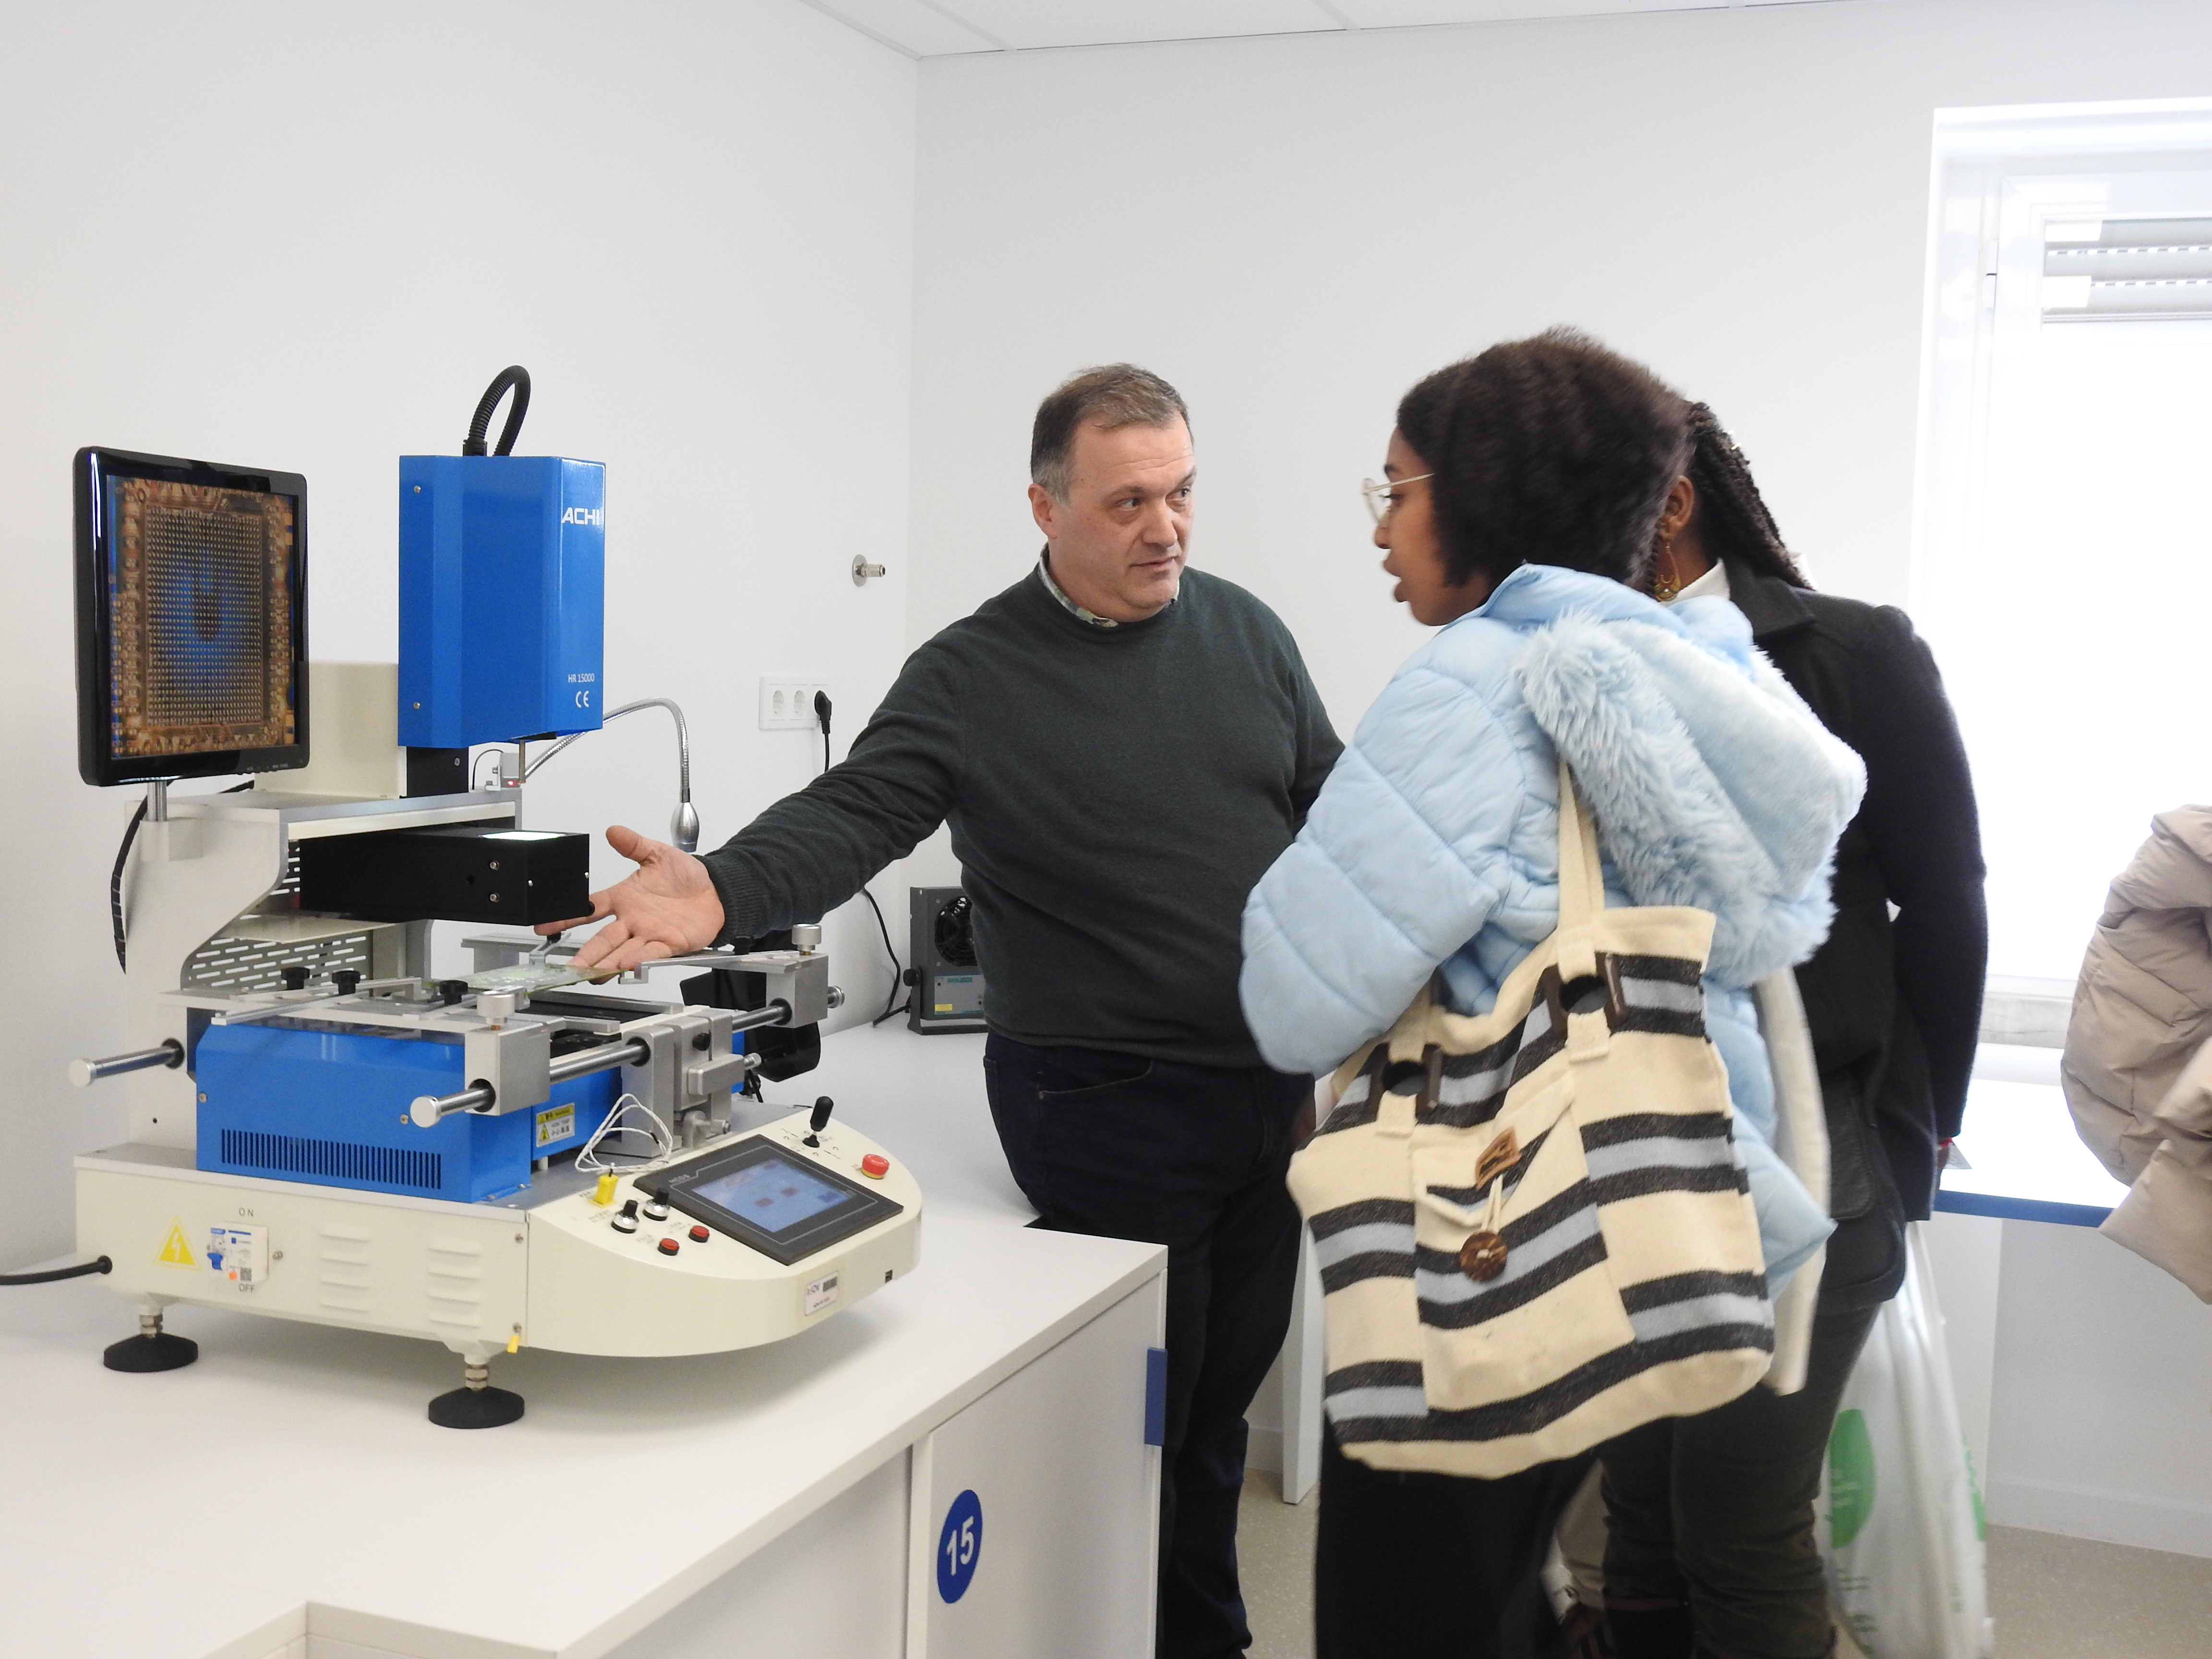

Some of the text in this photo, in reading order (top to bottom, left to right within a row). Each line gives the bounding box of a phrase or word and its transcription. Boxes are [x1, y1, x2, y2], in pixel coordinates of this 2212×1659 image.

[561, 507, 600, 525] ACHI
[568, 673, 595, 683] HR 15000
[576, 690, 589, 708] CE
[239, 1207, 254, 1217] ON
[239, 1283, 255, 1293] OFF
[947, 1515, 974, 1576] 15
